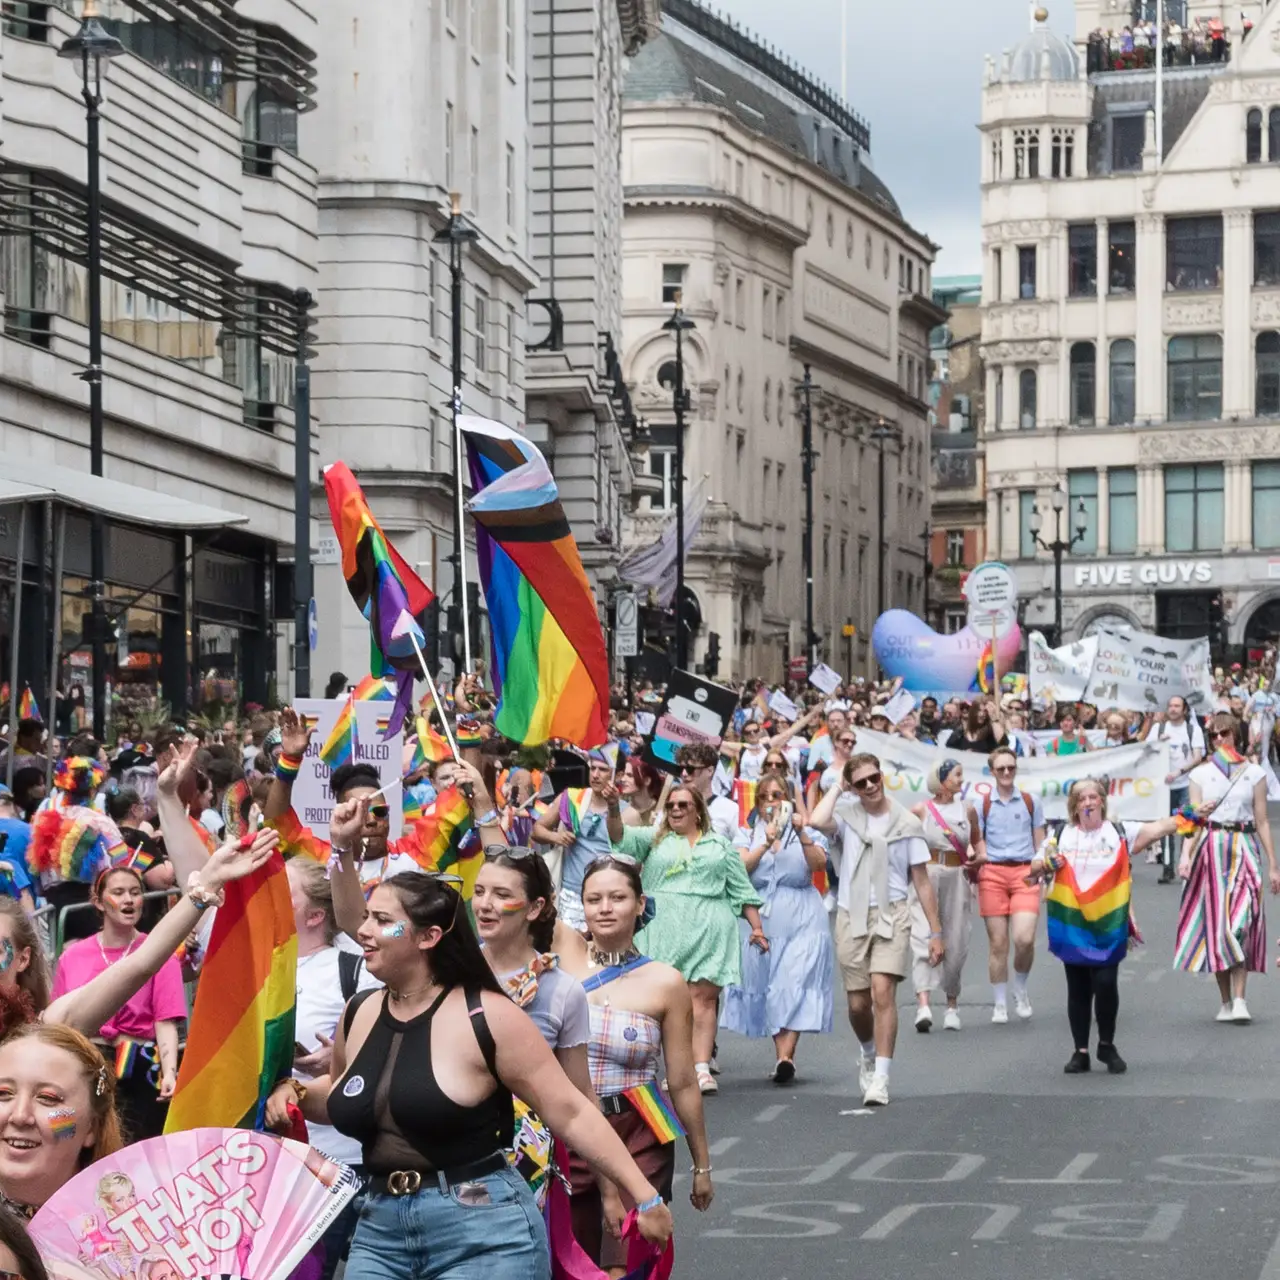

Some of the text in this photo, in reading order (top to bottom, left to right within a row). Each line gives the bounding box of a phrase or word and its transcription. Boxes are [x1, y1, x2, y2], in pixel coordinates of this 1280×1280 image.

[1074, 561, 1212, 586] FIVE GUYS
[1133, 656, 1166, 672] YOUR
[685, 709, 700, 723] END
[360, 745, 389, 760] ALLED
[306, 1191, 349, 1243] You Betta Merch
[700, 1200, 1188, 1243] BUS
[161, 1183, 264, 1278] HOT
